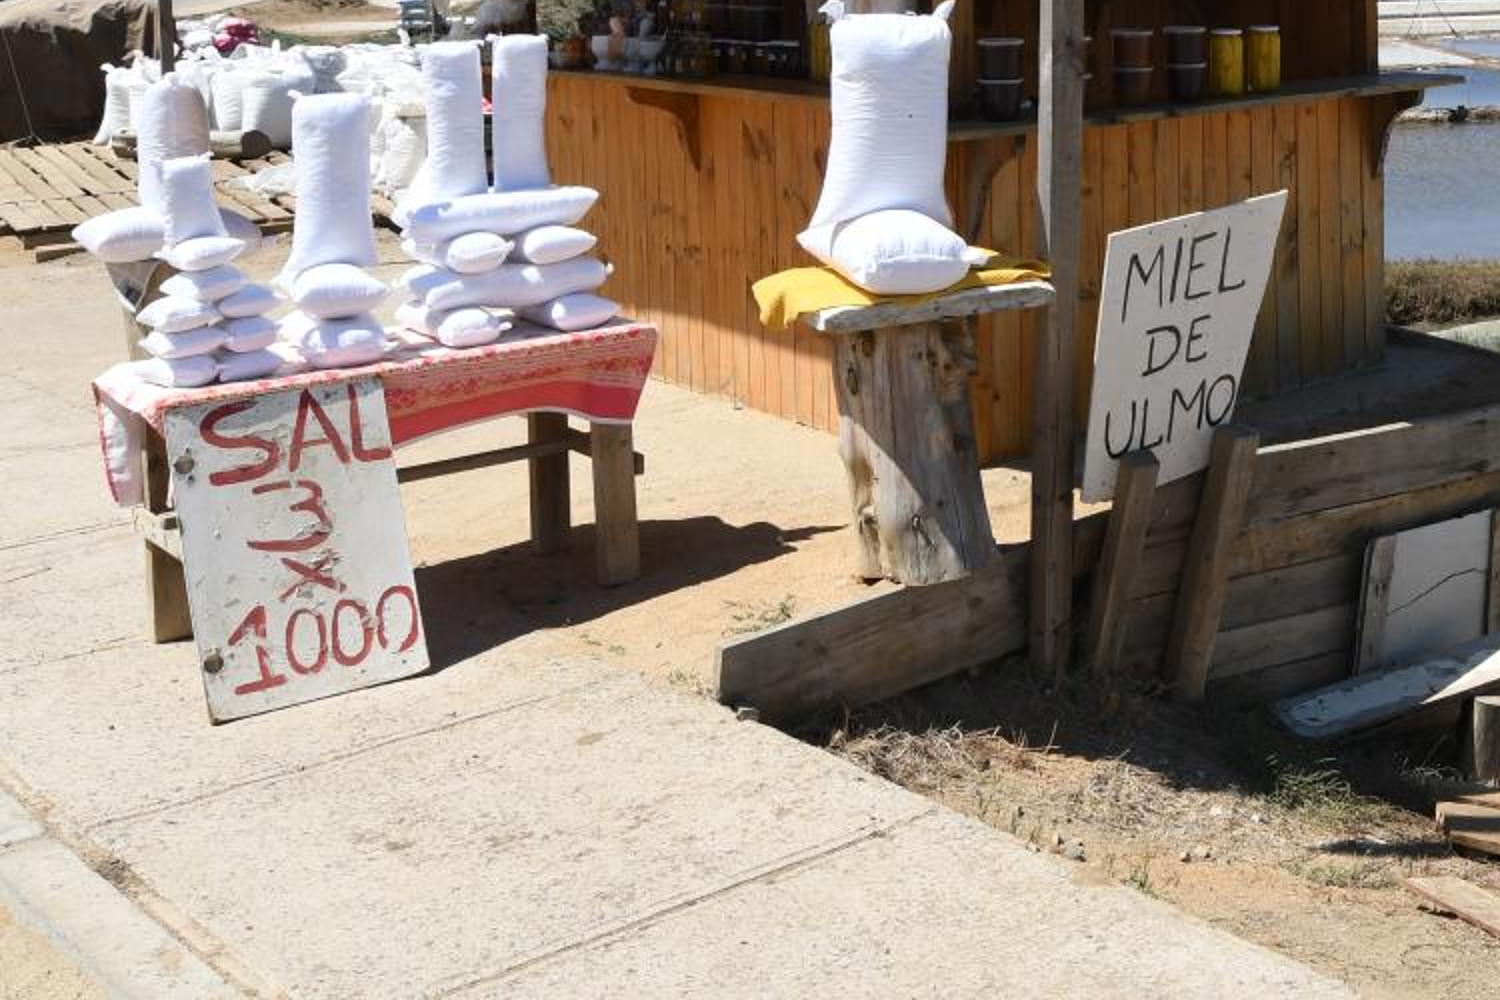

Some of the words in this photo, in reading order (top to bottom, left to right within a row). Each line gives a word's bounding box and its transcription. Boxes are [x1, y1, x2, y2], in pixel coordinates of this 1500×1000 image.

[1121, 227, 1246, 324] MIEL
[1141, 315, 1211, 377] DE
[199, 383, 393, 486] SAL
[1104, 374, 1237, 459] ULMO
[246, 479, 334, 553] 3
[227, 585, 420, 696] 1000
